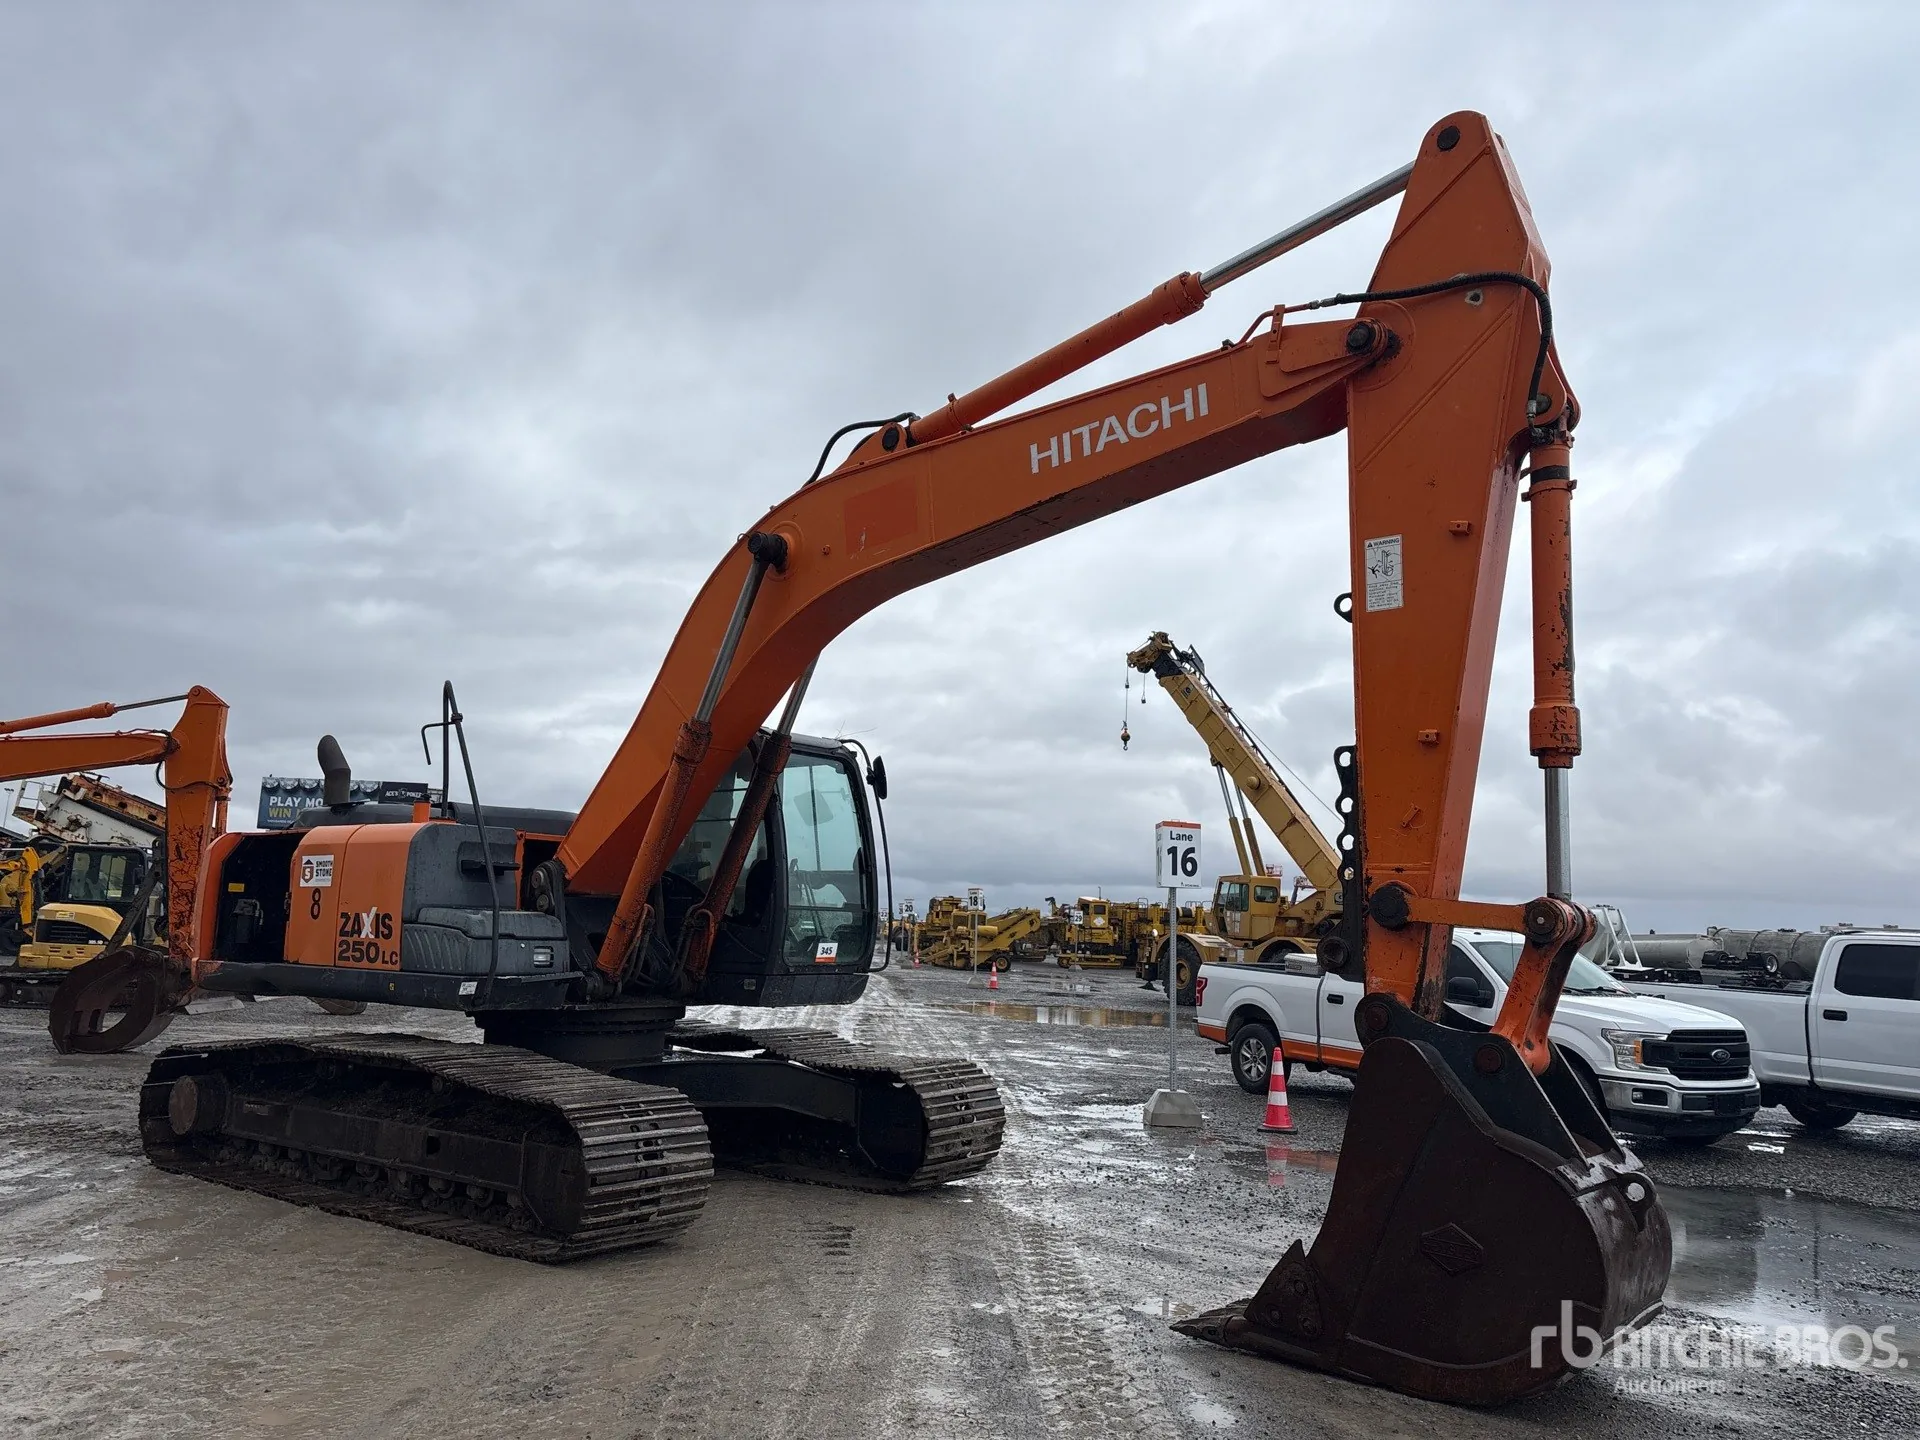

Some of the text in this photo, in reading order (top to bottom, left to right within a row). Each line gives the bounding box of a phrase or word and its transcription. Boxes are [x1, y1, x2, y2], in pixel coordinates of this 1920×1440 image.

[1029, 382, 1209, 475] HITACHI
[1373, 537, 1399, 546] WARNING
[270, 796, 302, 807] PLAY
[268, 808, 292, 818] WIN
[1170, 830, 1194, 842] Lane
[316, 860, 333, 868] SMOOTH
[1167, 845, 1198, 878] 16
[315, 868, 332, 877] STONE
[310, 887, 321, 920] 8
[968, 896, 978, 907] 18
[904, 904, 914, 912] 20
[339, 906, 393, 940] ZAXIS
[820, 946, 833, 955] 345
